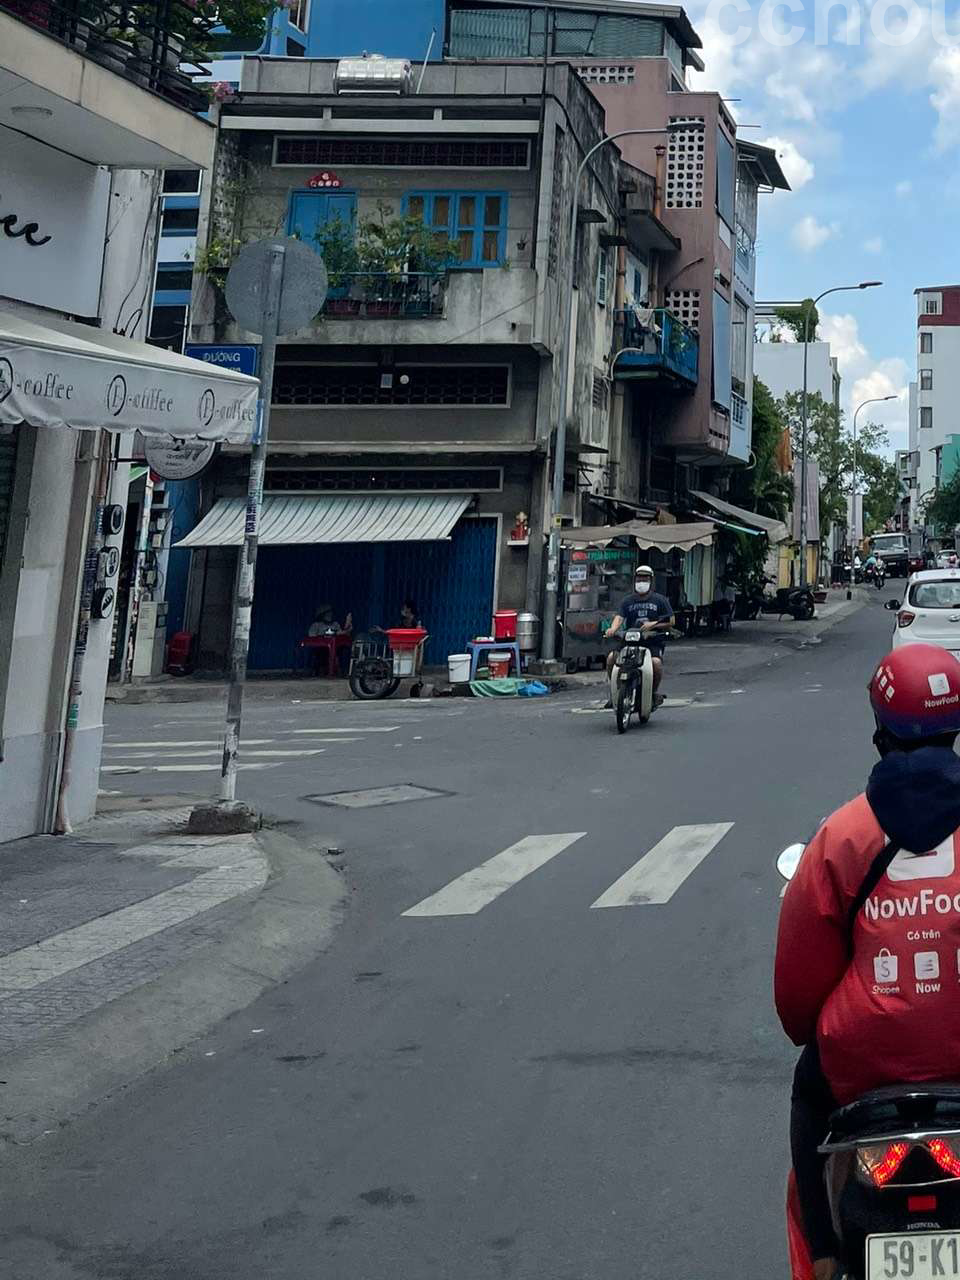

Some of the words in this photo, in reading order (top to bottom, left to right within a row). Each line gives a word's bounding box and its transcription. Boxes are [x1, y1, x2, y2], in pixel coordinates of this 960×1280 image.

[0, 214, 52, 247] ee
[924, 694, 960, 709] NowFood
[907, 930, 920, 941] Có
[922, 929, 941, 941] trên
[916, 982, 941, 994] Now
[907, 1222, 940, 1230] HONDA
[883, 1238, 959, 1279] 59-K1
